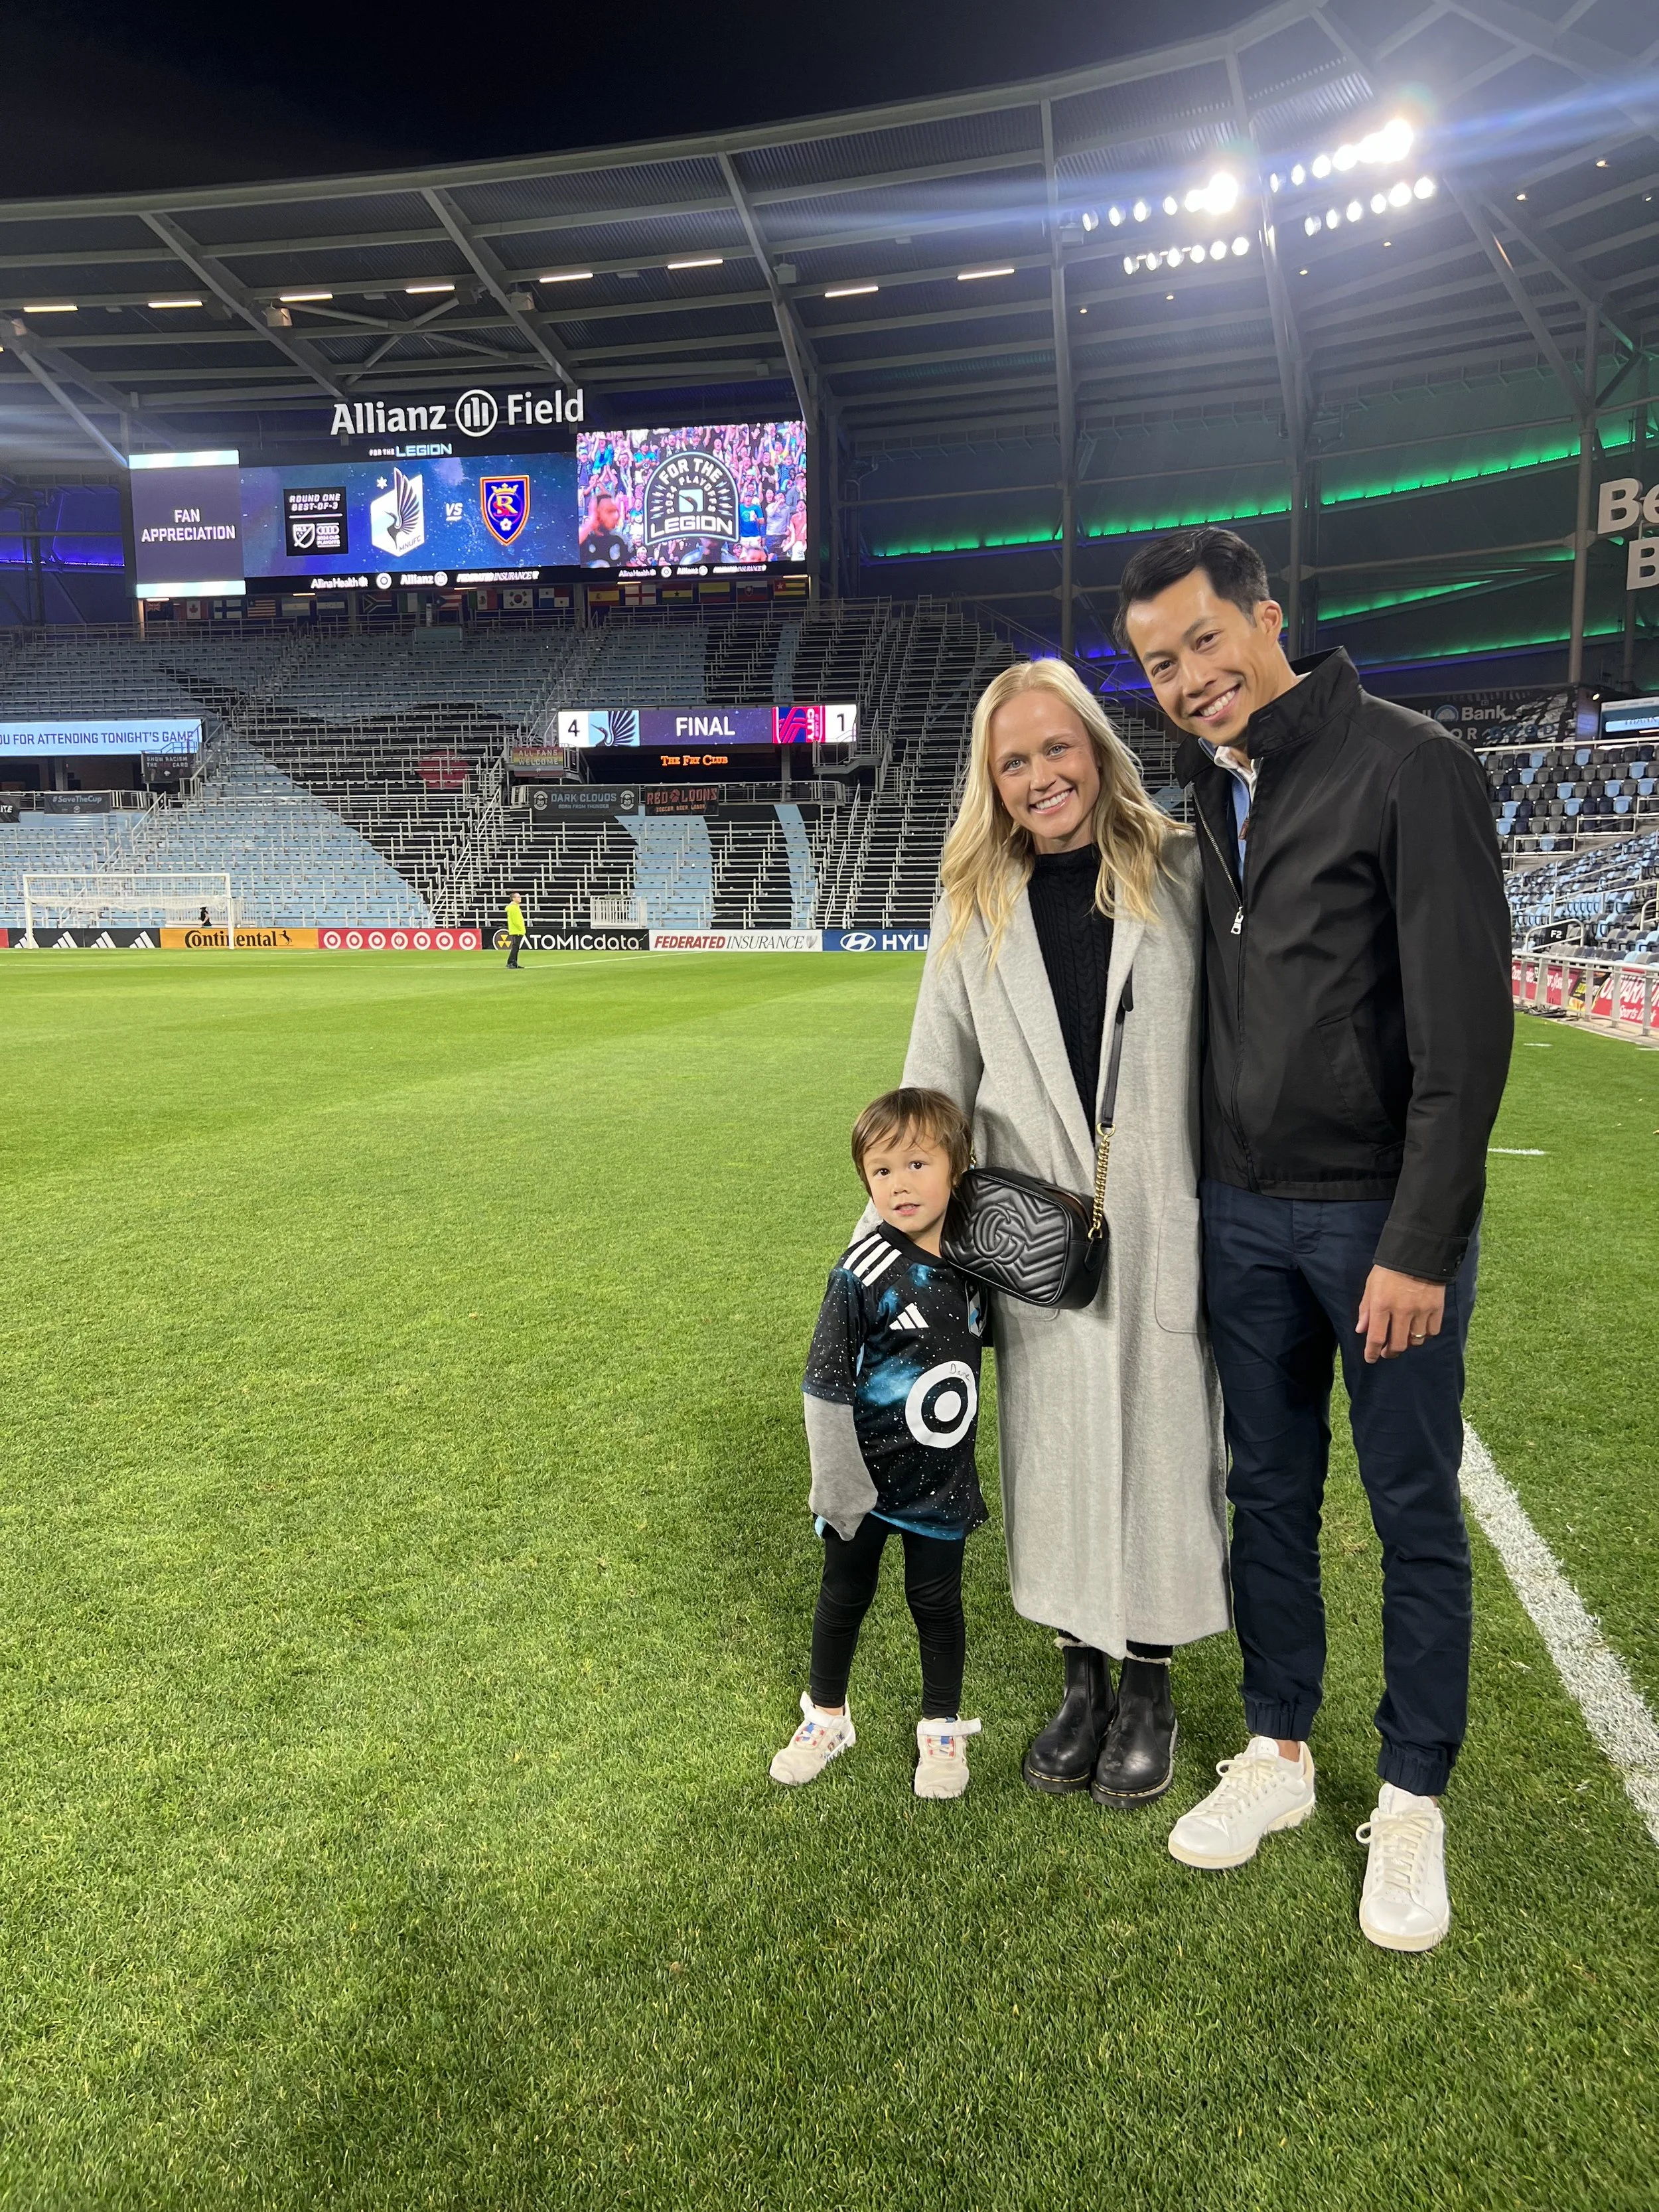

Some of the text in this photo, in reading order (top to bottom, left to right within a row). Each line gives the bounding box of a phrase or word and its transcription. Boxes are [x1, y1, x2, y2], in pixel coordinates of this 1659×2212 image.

[330, 388, 585, 435] Allianz Field
[396, 443, 452, 457] LEGION
[658, 457, 723, 485] FOR THE
[289, 493, 341, 503] ROUND ONE
[665, 475, 717, 514] 2024 PLAYOFFS
[291, 501, 338, 512] BEST-OF-3
[175, 508, 200, 523] FAN
[141, 525, 236, 542] APPRECIATION
[650, 514, 733, 538] LEGION
[399, 535, 421, 552] MNUFC
[400, 573, 434, 585] Allianz
[1461, 704, 1506, 721] Bank
[567, 719, 581, 737] 4
[676, 715, 736, 737] FINAL
[807, 708, 816, 739] CITY
[837, 713, 845, 731] 1
[13, 733, 35, 745] FOR
[37, 733, 99, 744] ATTENDING
[101, 731, 159, 743] TONIGHT'S
[162, 731, 194, 742] GAME
[660, 755, 681, 766] THE
[703, 754, 728, 766] CLUB
[52, 794, 102, 804] #SaveTheCup
[551, 792, 617, 802] DARK CLOUDS
[646, 787, 717, 805] RED LOONS
[654, 936, 805, 949] FEDERATED INSURANCE
[1550, 930, 1562, 939] F2
